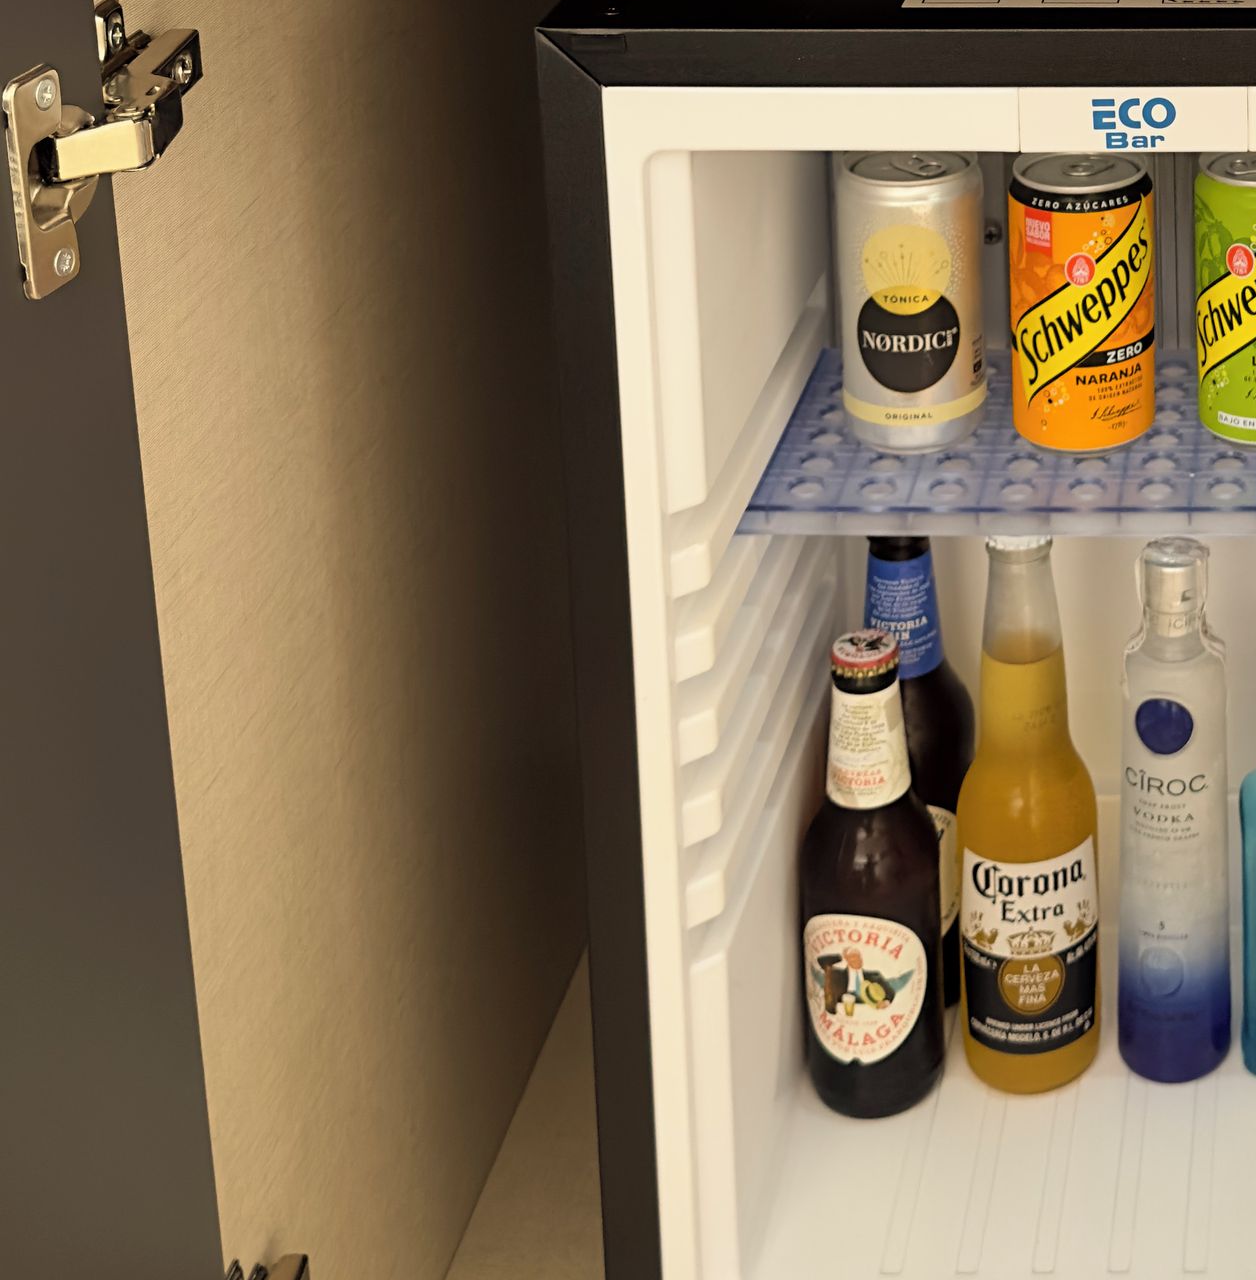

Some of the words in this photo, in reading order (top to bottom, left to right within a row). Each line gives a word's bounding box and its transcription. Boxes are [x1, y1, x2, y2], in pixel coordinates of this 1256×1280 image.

[1091, 97, 1177, 131] ECO
[1105, 131, 1166, 150] Bar
[1031, 197, 1060, 210] ZERO
[1065, 194, 1129, 211] AZÚCARES
[1020, 225, 1148, 386] Schweppes
[1106, 341, 1143, 364] ZERO
[1075, 362, 1142, 386] NARANJA
[884, 412, 933, 421] ORIGINAL
[1219, 414, 1240, 426] BAJO
[1243, 419, 1255, 427] EN
[870, 615, 928, 631] VICTORIA
[1132, 805, 1195, 824] VODKA
[971, 858, 1084, 904] Corona
[1000, 899, 1065, 923] Extra
[808, 928, 904, 960] VICTORIA
[1003, 968, 1061, 985] CERVEZA
[1022, 962, 1041, 974] LA
[1018, 991, 1047, 1006] FINA
